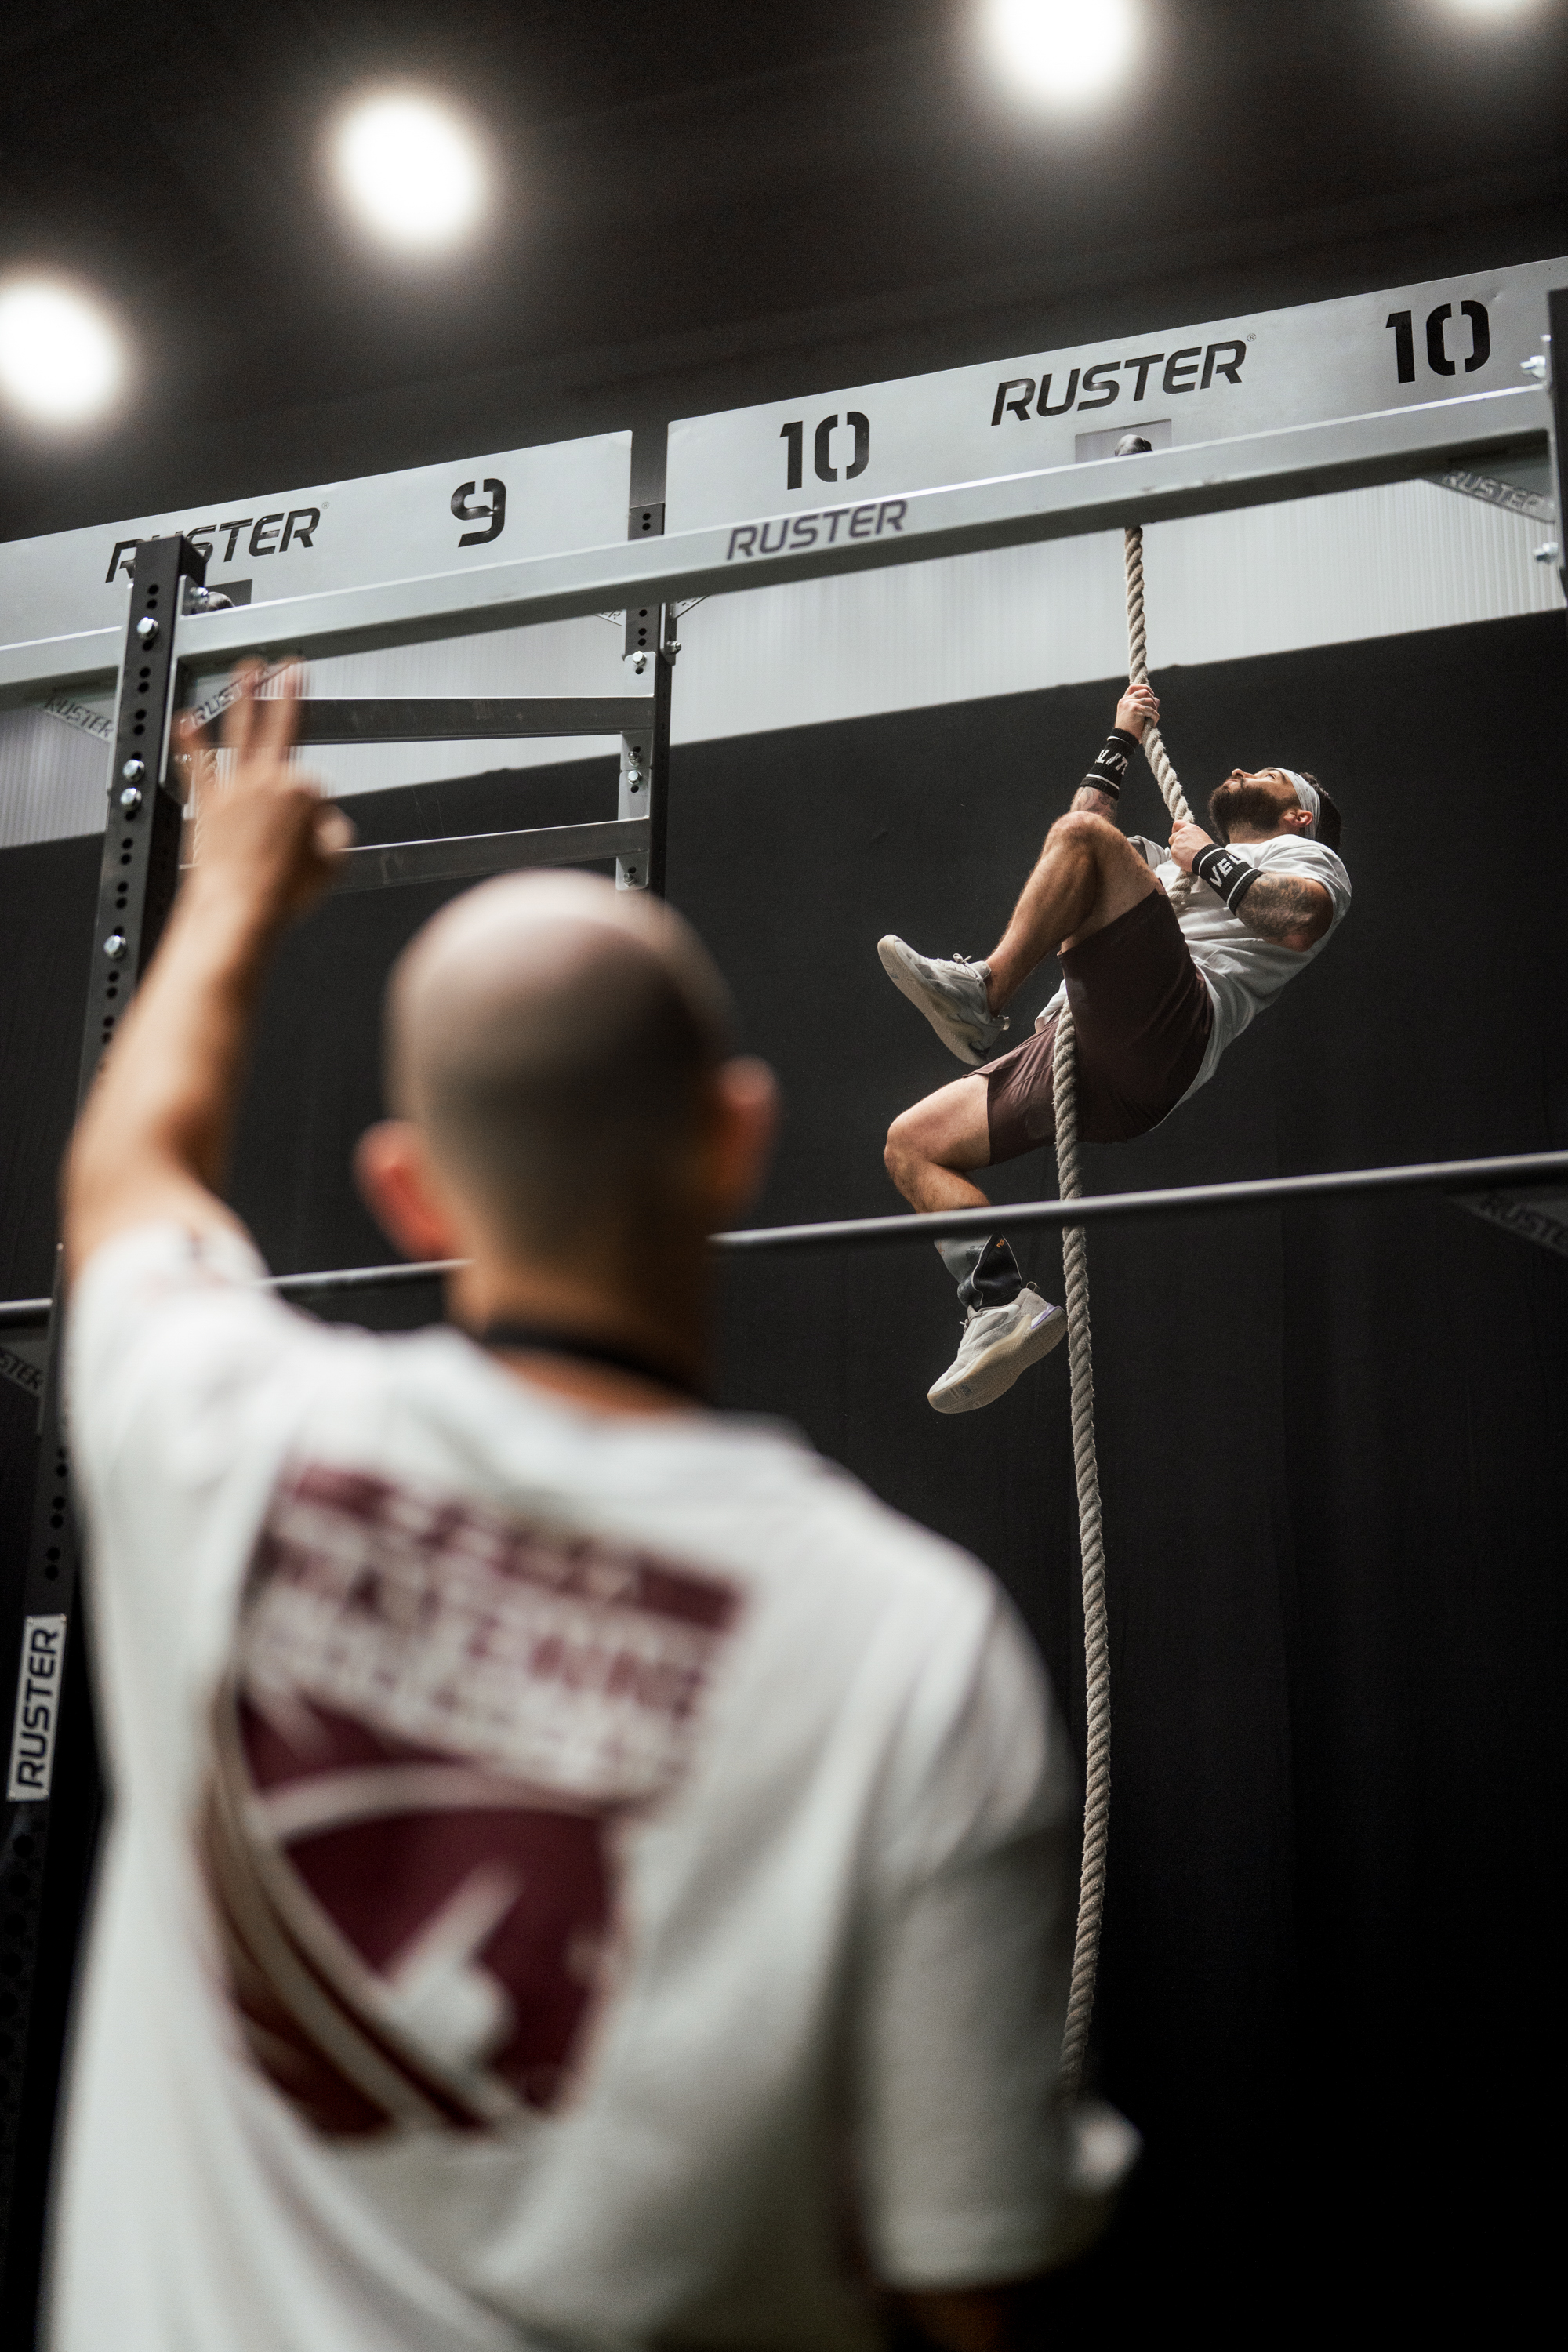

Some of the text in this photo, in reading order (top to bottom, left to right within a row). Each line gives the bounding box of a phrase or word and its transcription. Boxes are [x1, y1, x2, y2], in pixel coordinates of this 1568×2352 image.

[779, 411, 870, 491] 10
[1385, 300, 1491, 384] 10
[105, 477, 506, 583] RSTER 9
[727, 499, 908, 561] RUSTER
[16, 1628, 59, 1788] RUSTER
